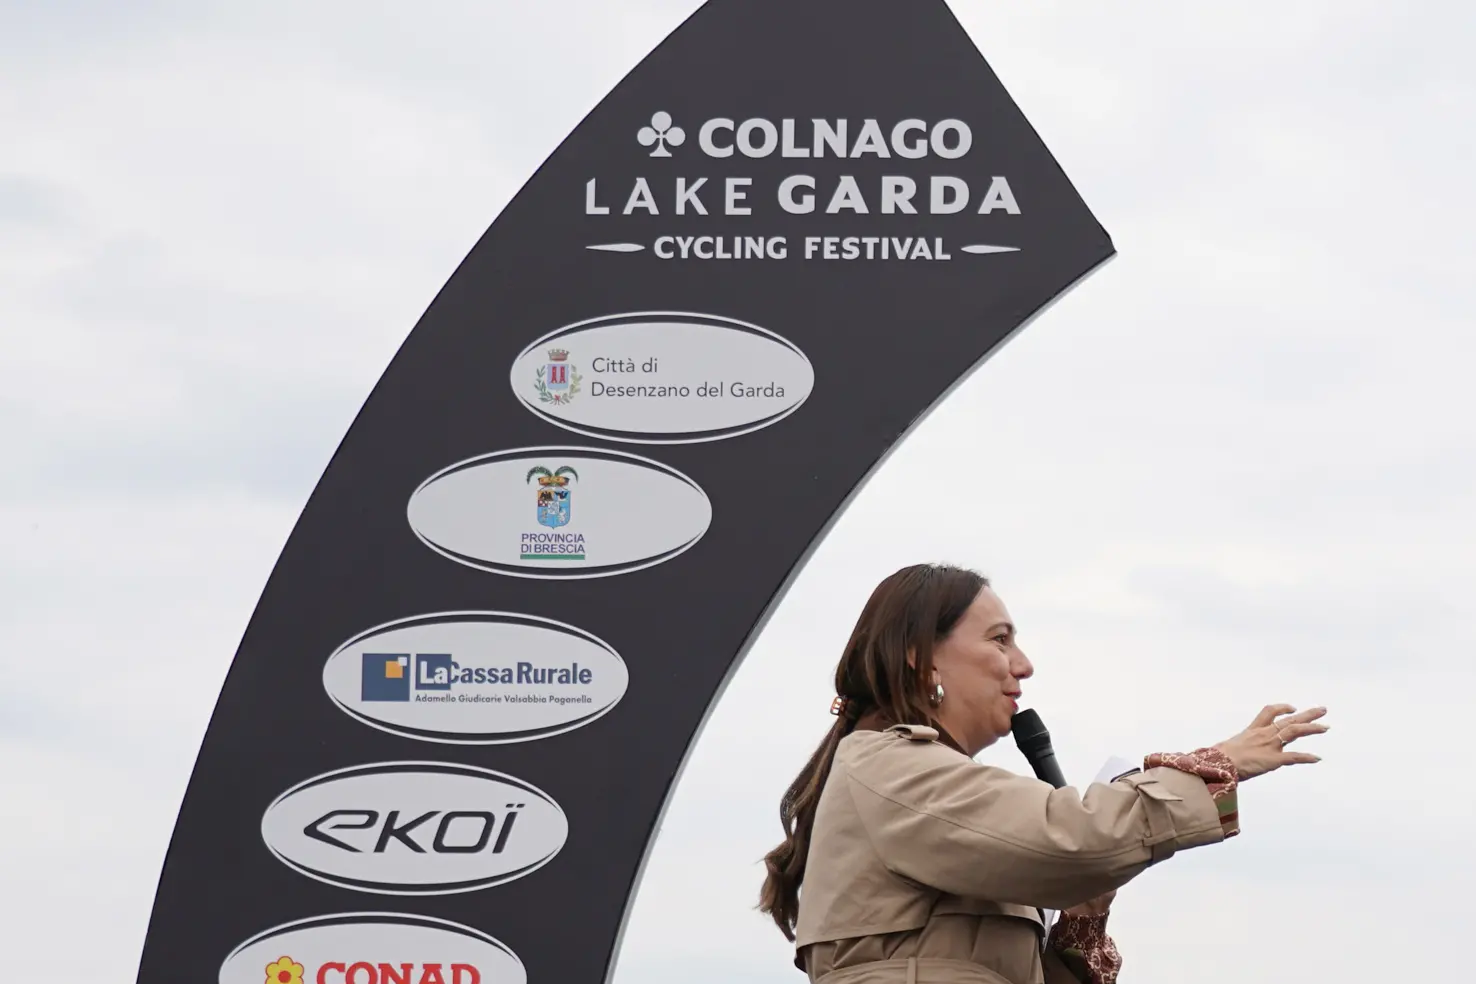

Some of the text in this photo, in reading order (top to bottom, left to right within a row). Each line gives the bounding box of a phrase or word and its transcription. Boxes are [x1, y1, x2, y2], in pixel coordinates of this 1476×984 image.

[698, 117, 973, 160] COLNAGO
[585, 174, 1022, 216] LAKE GARDA
[653, 235, 952, 261] CYCLING FESTIVAL
[592, 357, 659, 374] Città di
[591, 381, 786, 399] Desenzano del Garda
[521, 533, 585, 543] PROVINCIA
[520, 543, 585, 553] DI BRESCIA
[516, 661, 593, 685] Rurale
[415, 694, 593, 706] Adamello Giudicarie Valsabbia Paganella
